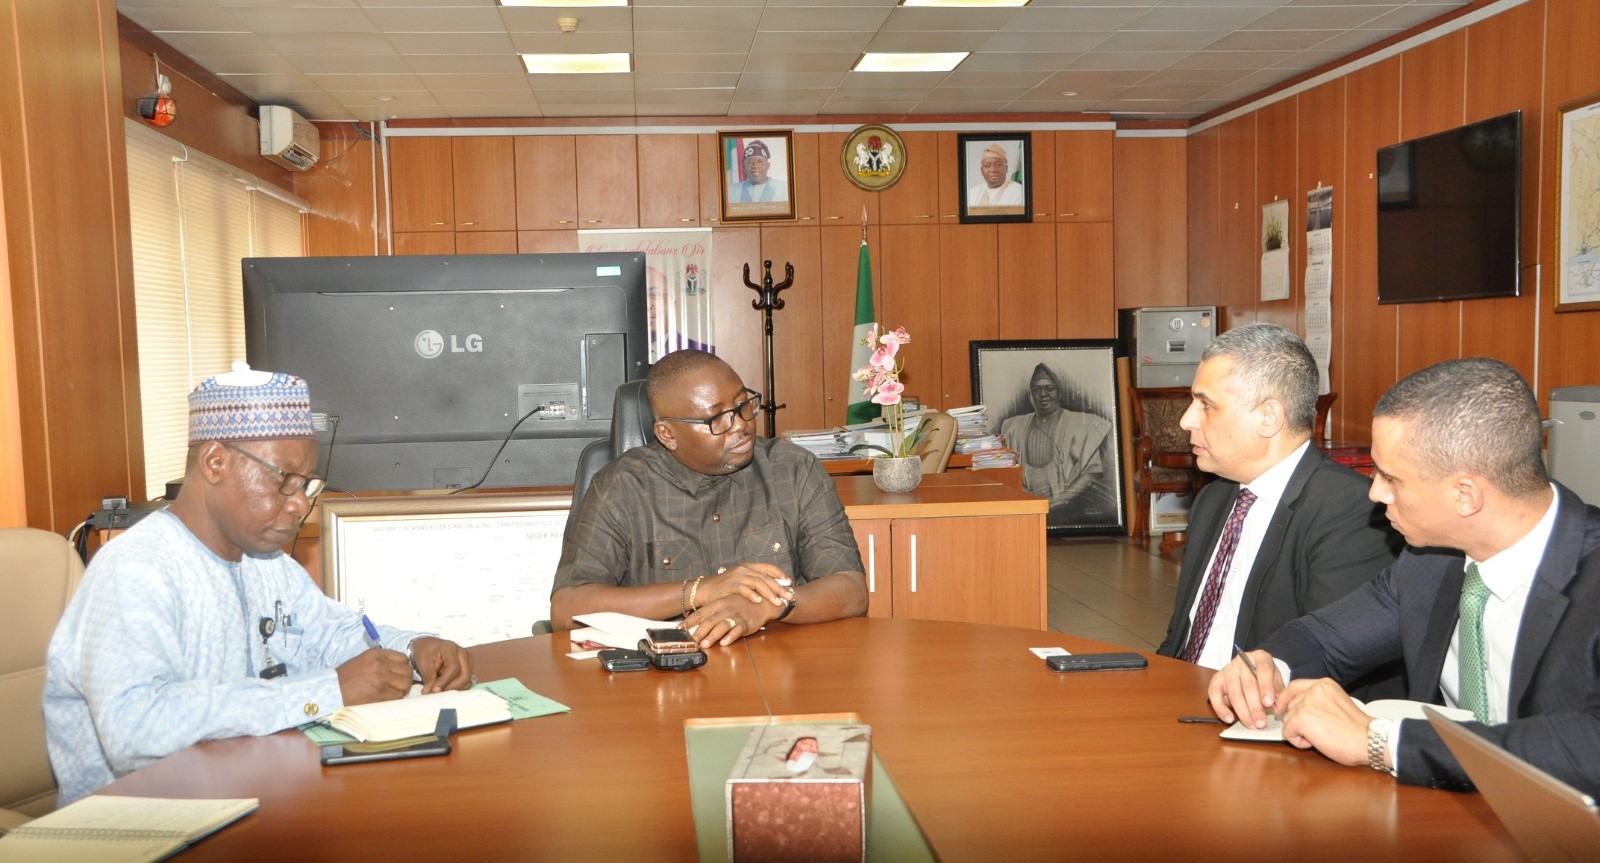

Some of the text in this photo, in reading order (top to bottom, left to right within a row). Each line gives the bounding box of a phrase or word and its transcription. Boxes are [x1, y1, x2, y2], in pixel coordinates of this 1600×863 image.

[682, 241, 705, 257] Sir
[450, 333, 483, 353] LG
[526, 532, 548, 540] NIGER
